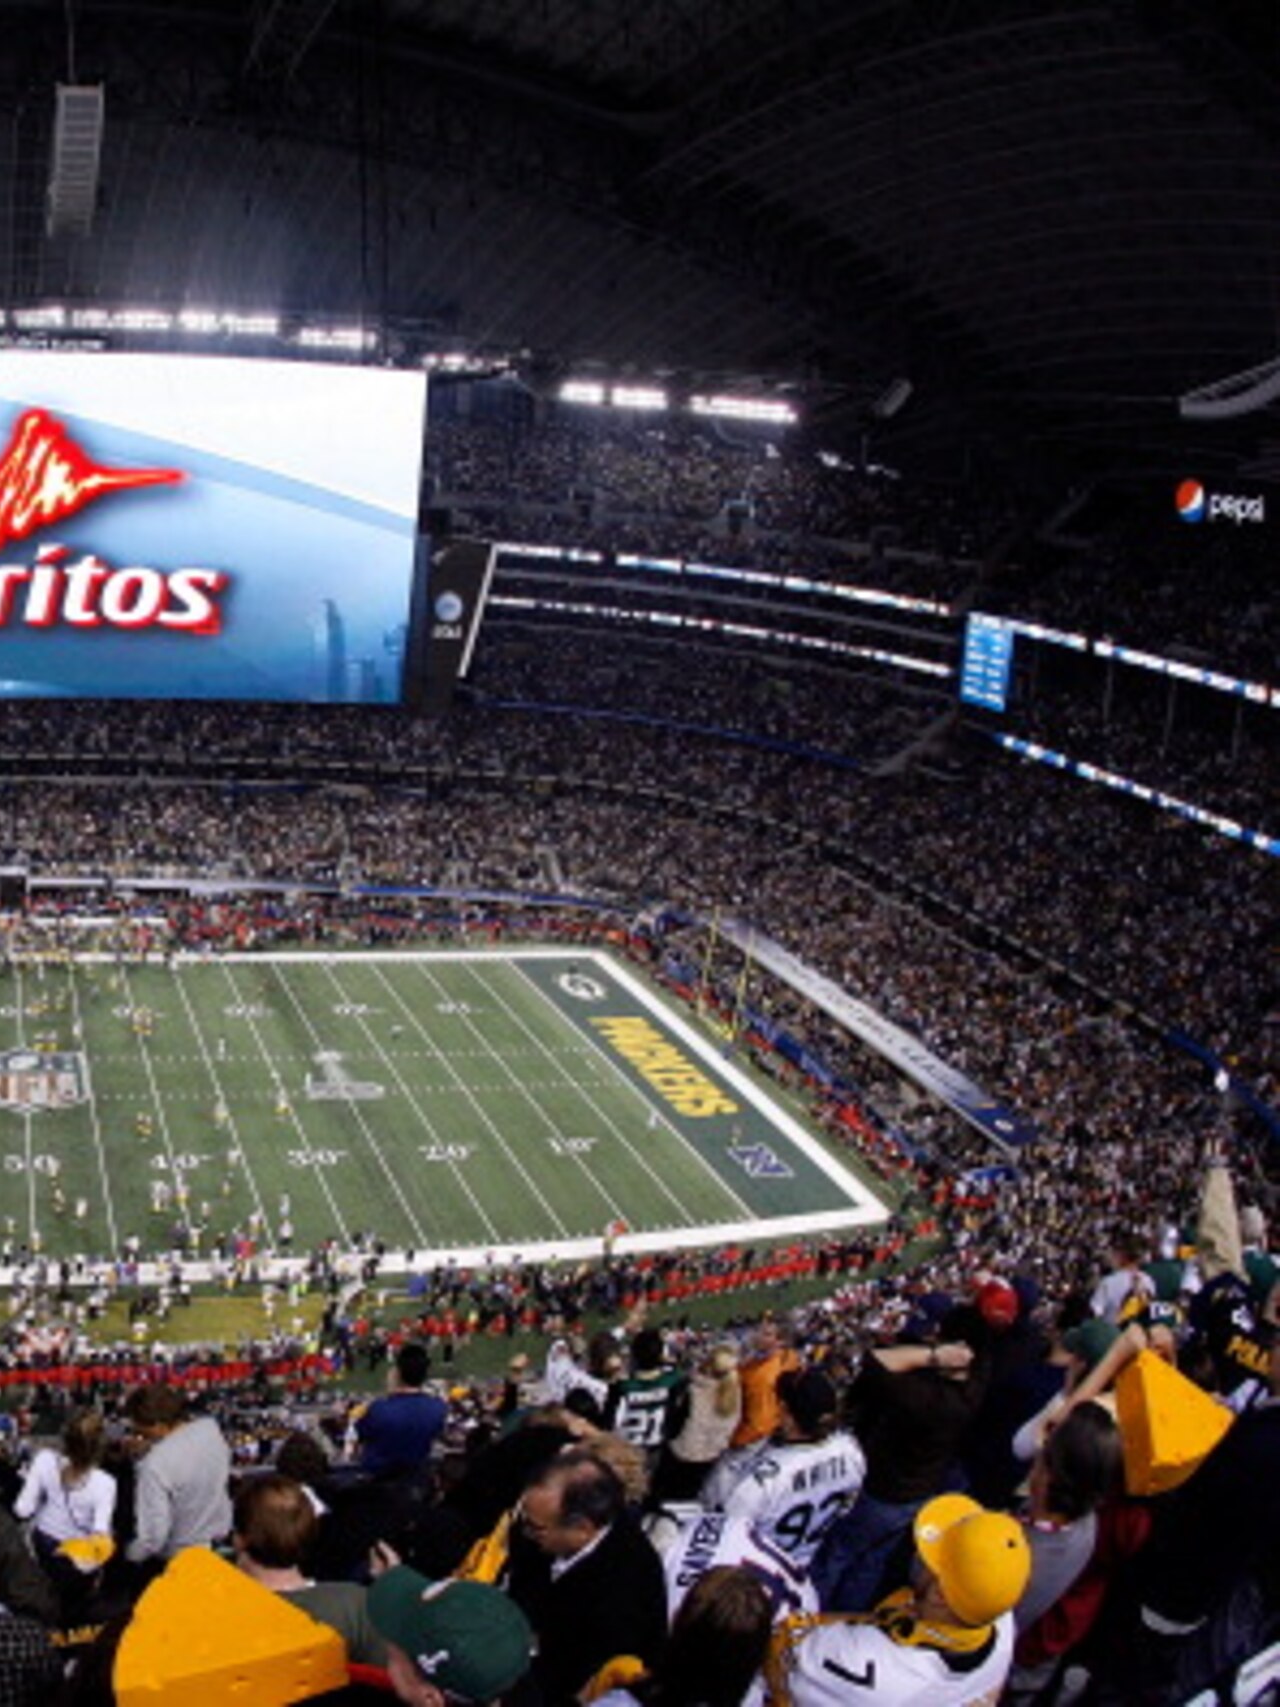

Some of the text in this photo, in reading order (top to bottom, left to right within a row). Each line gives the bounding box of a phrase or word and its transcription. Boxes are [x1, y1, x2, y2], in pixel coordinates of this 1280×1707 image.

[1209, 493, 1265, 526] pepsi
[3, 1154, 60, 1173] 50
[149, 1153, 200, 1171] 40
[790, 1456, 847, 1492] WHITE
[774, 1491, 858, 1553] 92
[822, 1659, 876, 1691] 7
